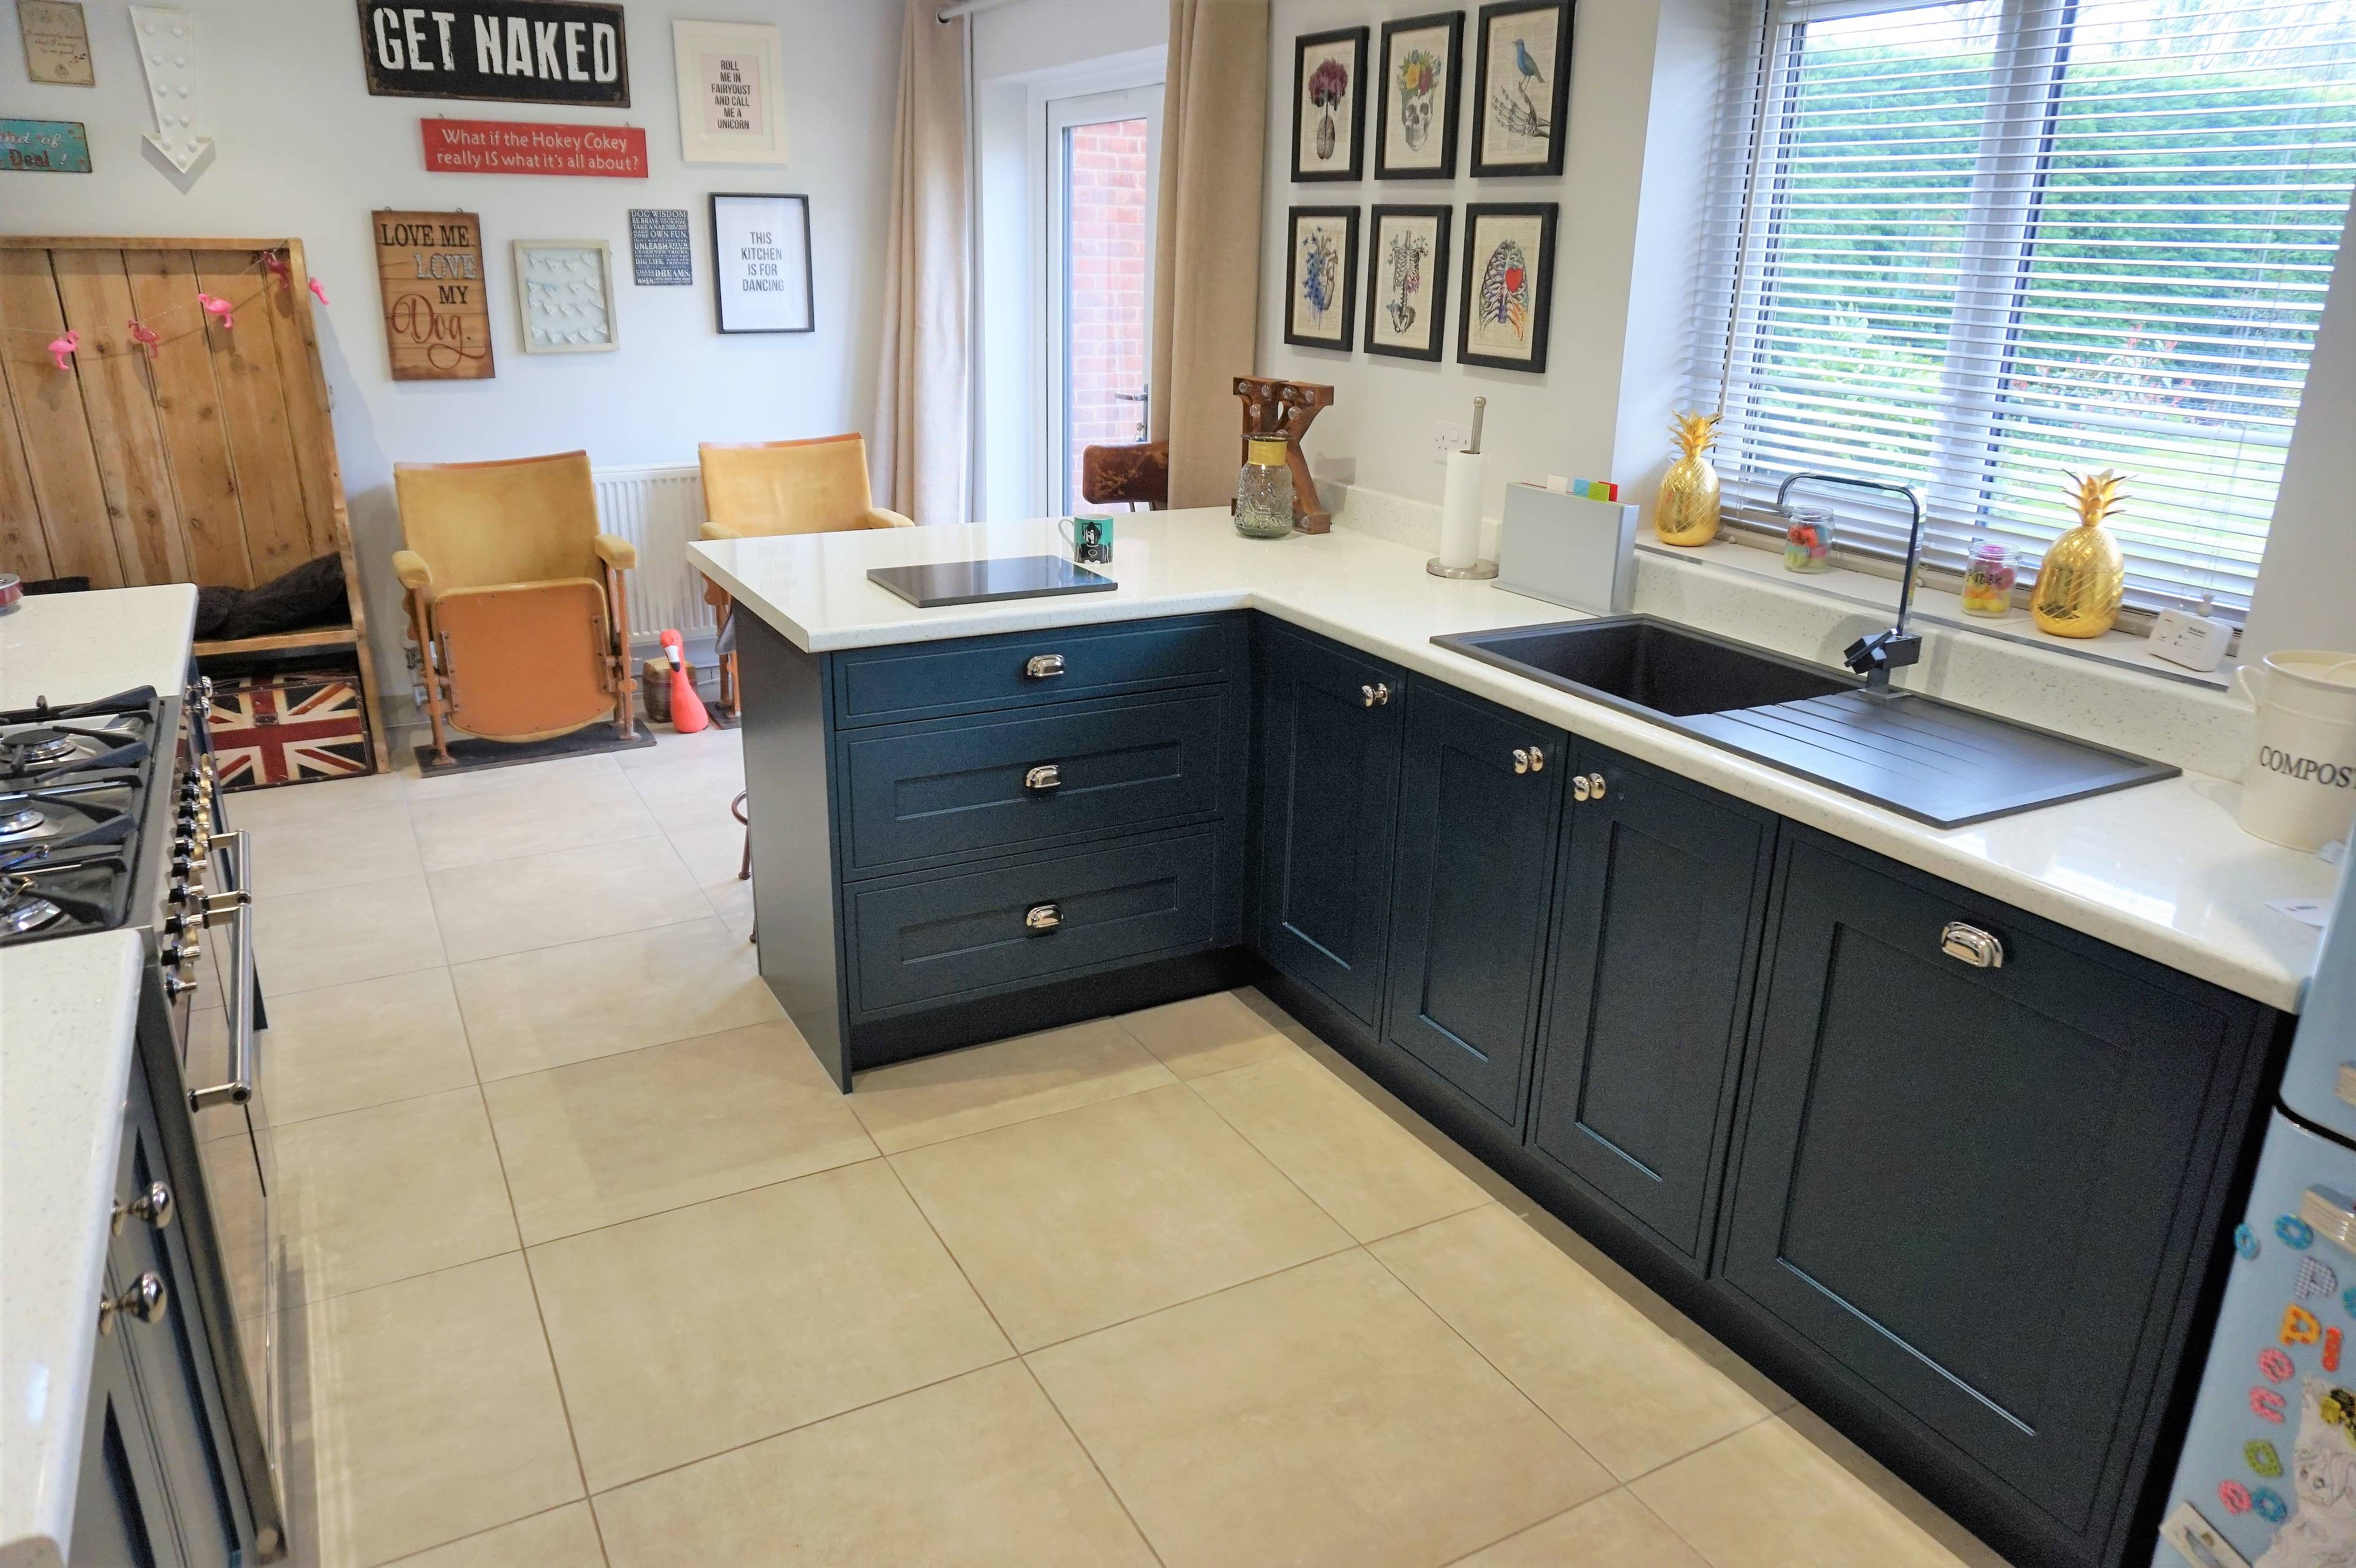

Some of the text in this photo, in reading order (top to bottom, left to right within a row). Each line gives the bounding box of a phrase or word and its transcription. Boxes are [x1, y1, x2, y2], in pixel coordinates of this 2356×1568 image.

[373, 7, 617, 82] GET NAKED
[720, 60, 739, 71] ROLL
[720, 72, 741, 82] ME IN
[711, 83, 751, 94] FAIRYDUST
[715, 96, 750, 106] AND CALL
[723, 107, 742, 118] ME A
[717, 119, 750, 129] UNICORN
[441, 128, 628, 153] What if the Hokey Cokey
[436, 150, 638, 171] really IS what it's all about?
[381, 223, 469, 247] LOVE ME
[749, 231, 772, 244] THIS
[741, 247, 782, 261] KITCHEN
[414, 252, 477, 280] LOVE
[748, 263, 778, 276] IS FOR
[742, 279, 785, 291] DANCING
[437, 285, 468, 304] MY
[2260, 745, 2356, 790] COMPOS
